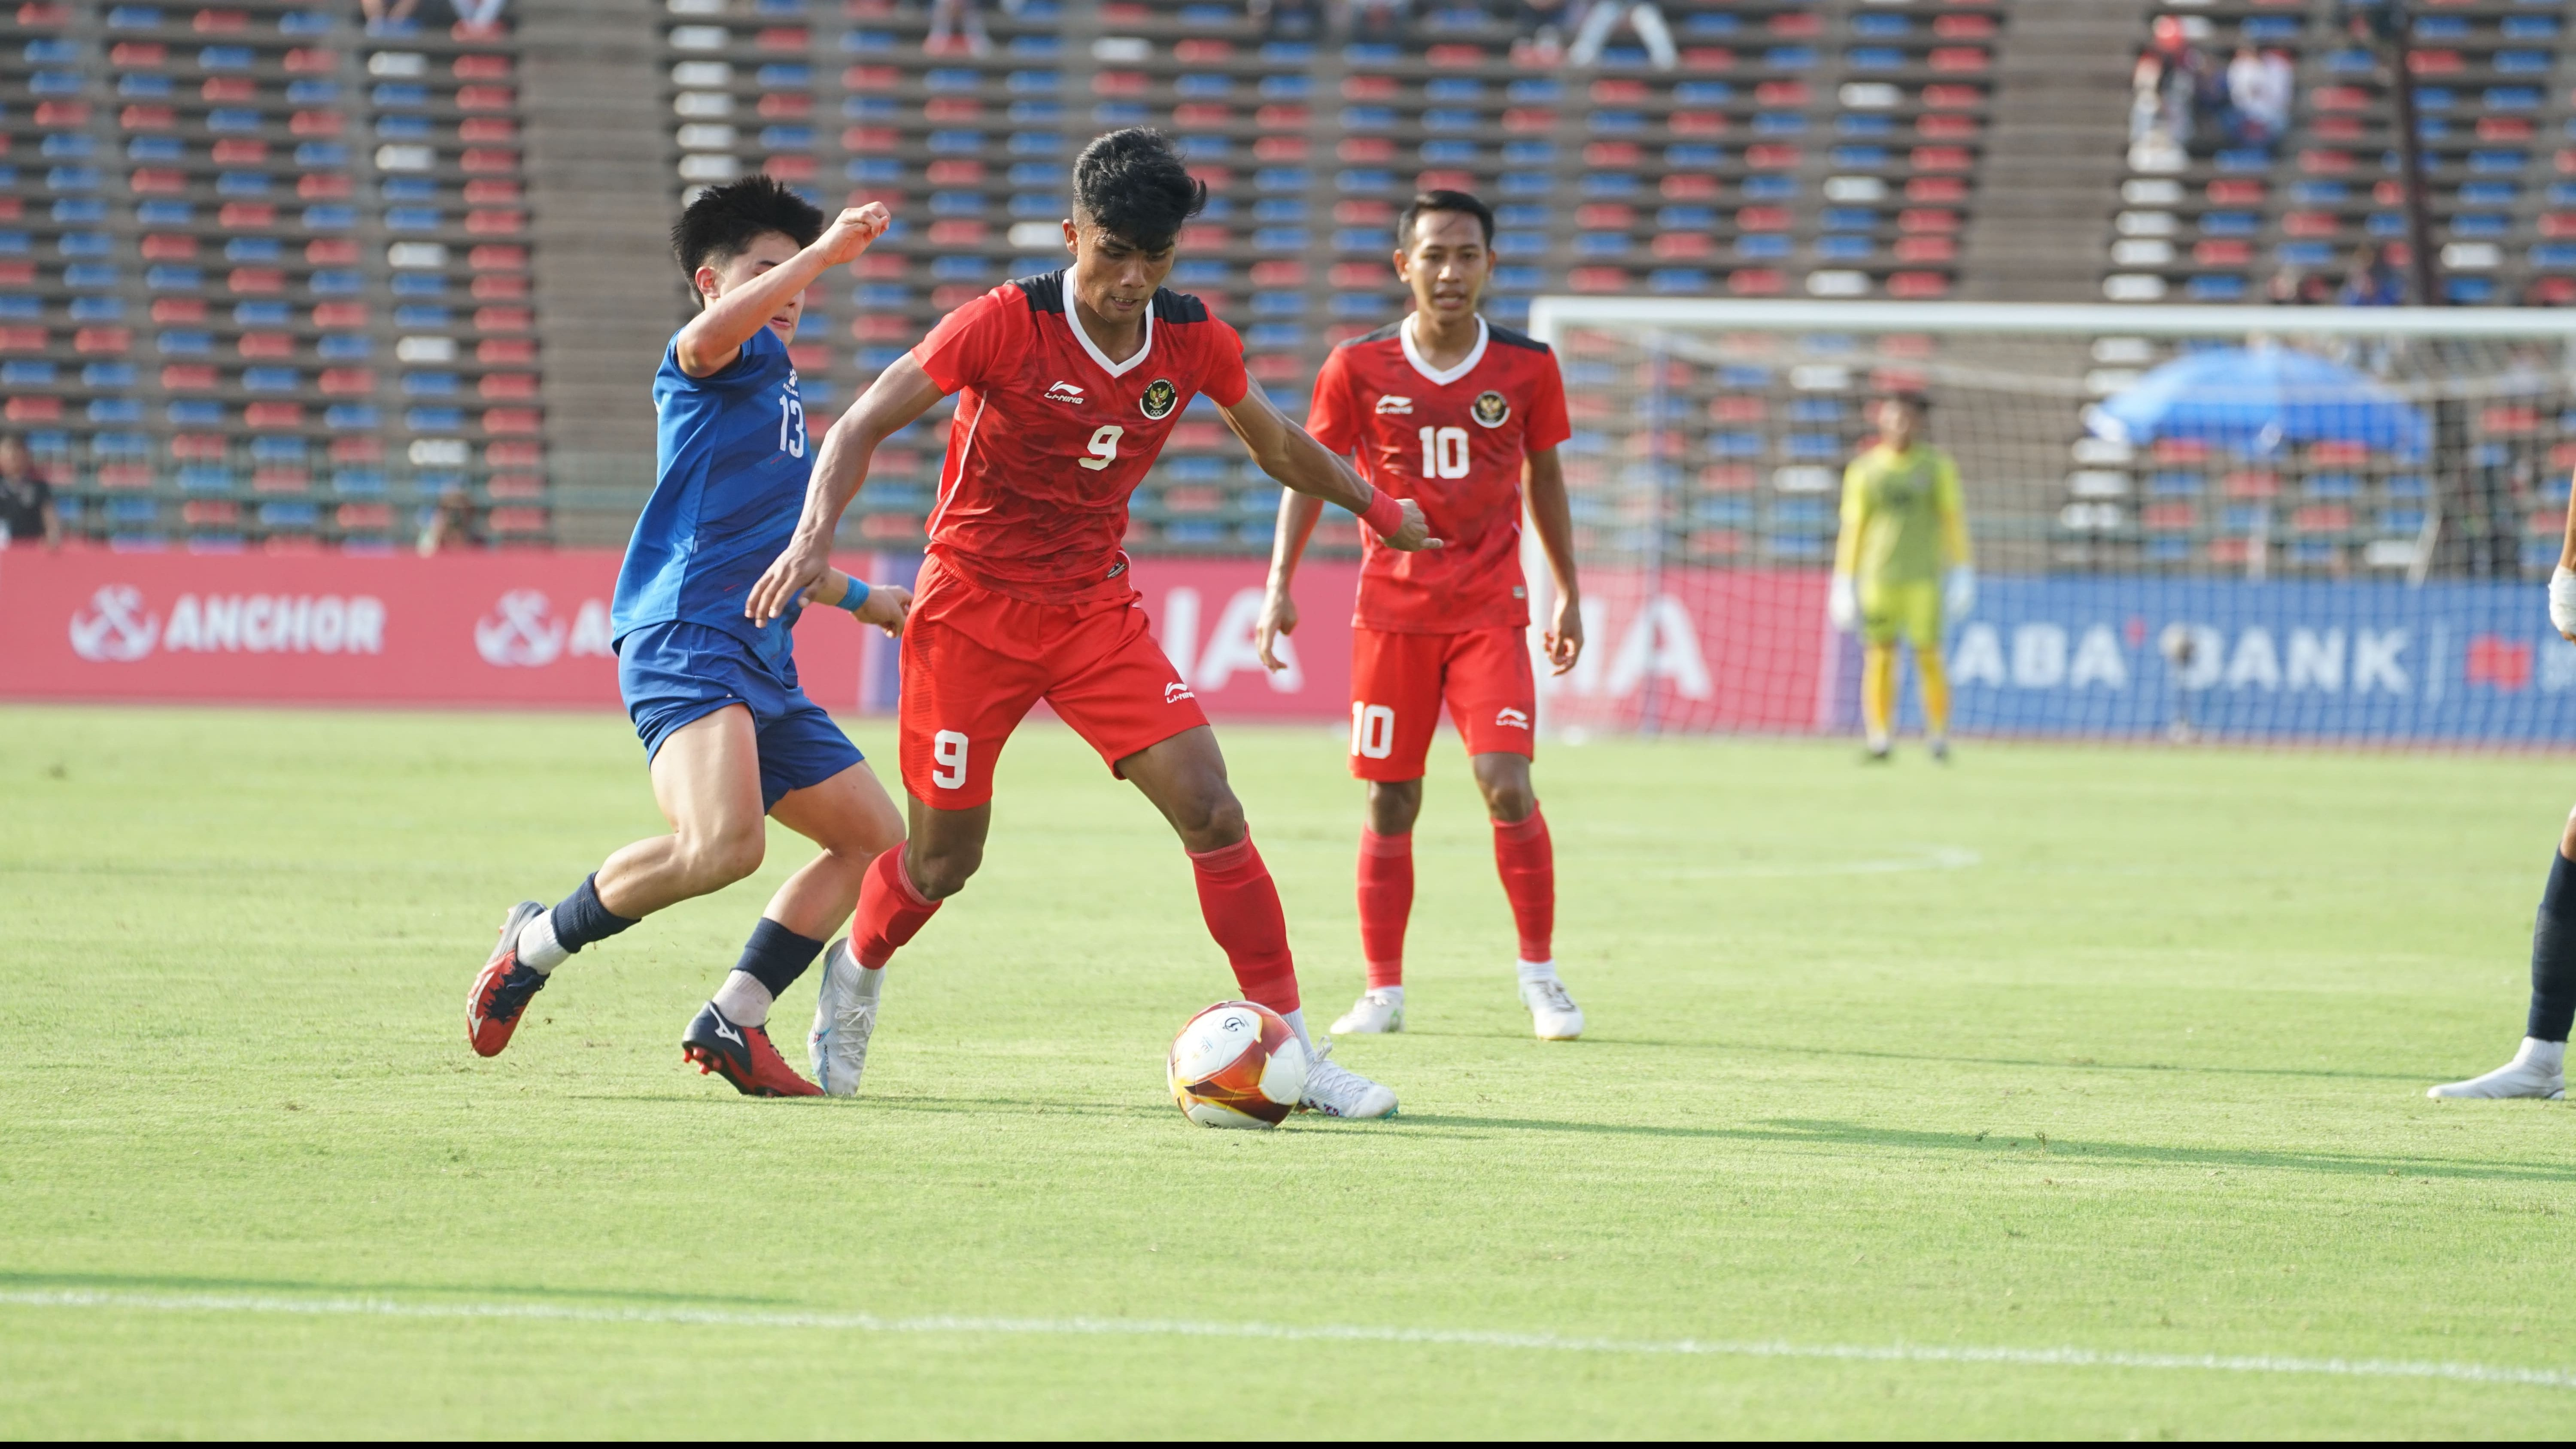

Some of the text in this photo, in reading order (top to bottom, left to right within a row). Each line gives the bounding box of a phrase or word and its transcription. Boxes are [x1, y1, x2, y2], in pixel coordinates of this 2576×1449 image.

[783, 383, 799, 397] KELME
[1044, 392, 1084, 404] LI-NING
[779, 394, 804, 458] 13
[1078, 425, 1124, 471] 9
[1419, 426, 1470, 479] 10
[164, 592, 386, 654] ANCHOR
[1951, 622, 2129, 689] ABA
[1166, 691, 1194, 704] LI-NIN
[1351, 701, 1394, 759] 10
[933, 729, 968, 789] 9
